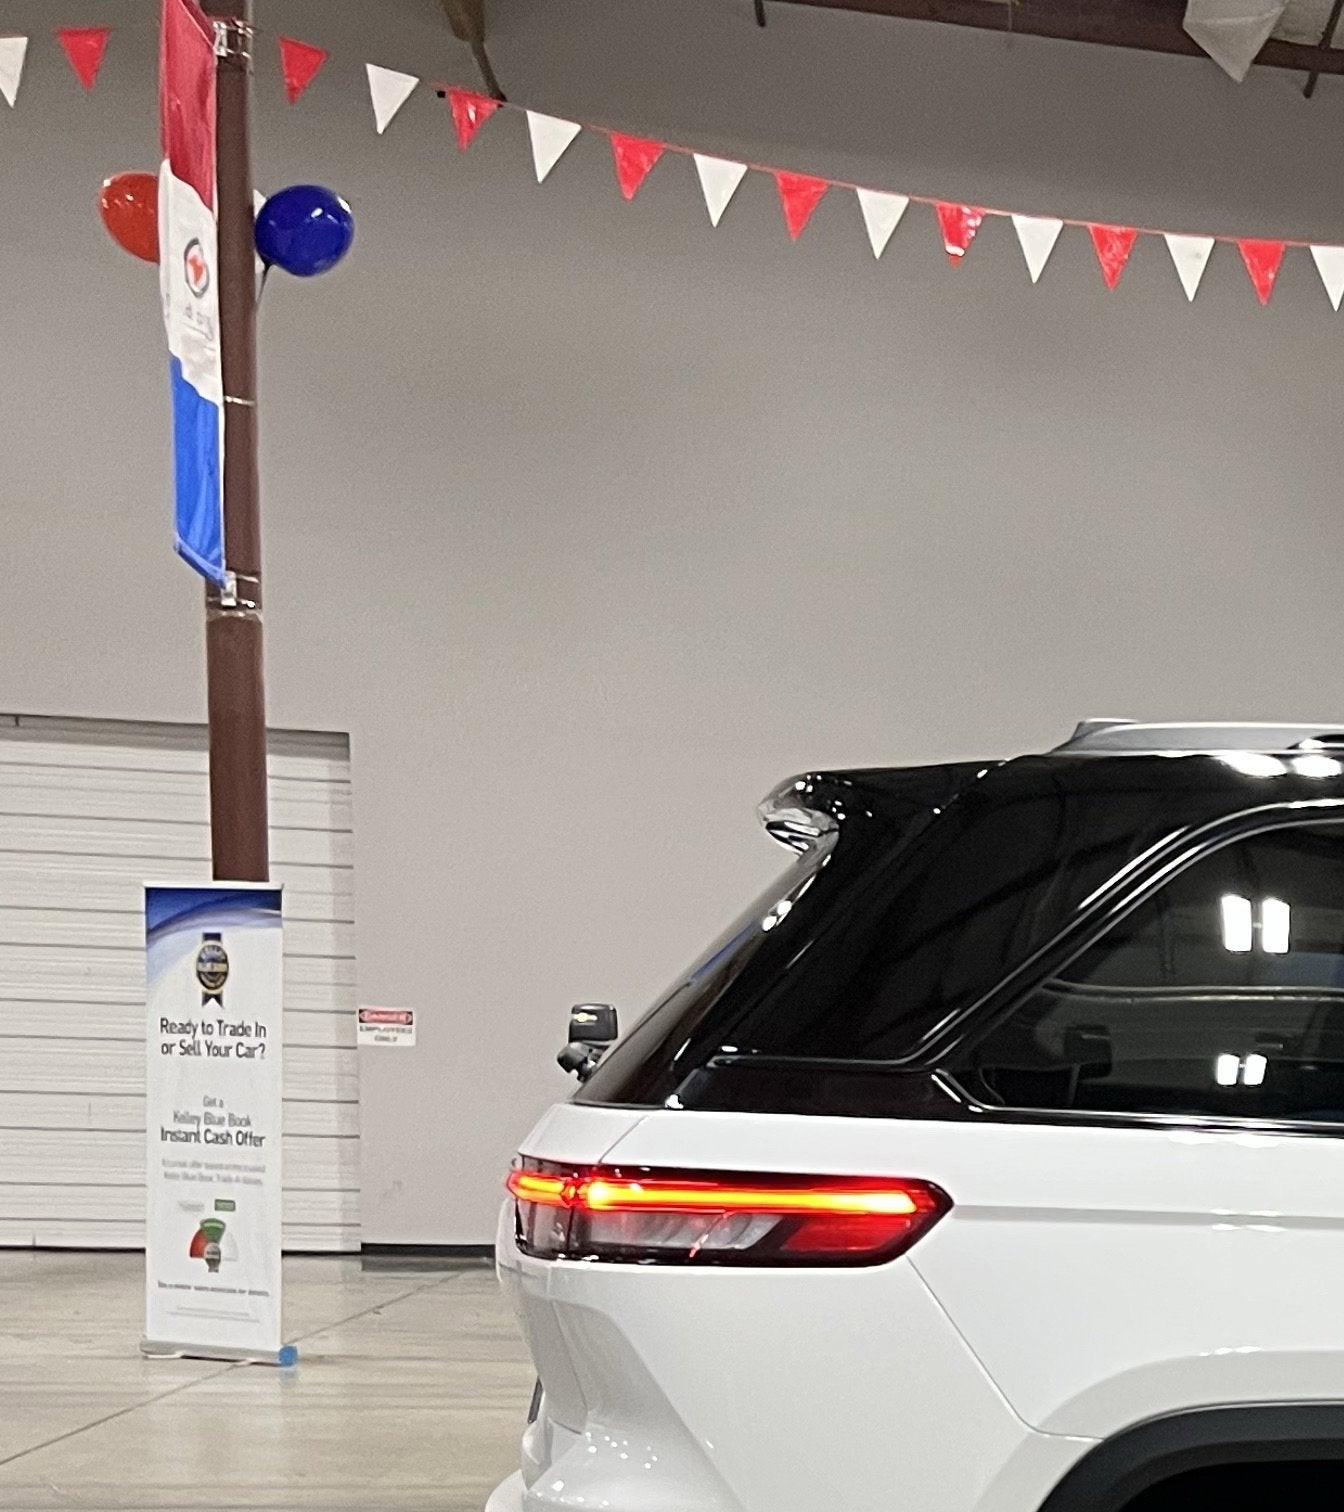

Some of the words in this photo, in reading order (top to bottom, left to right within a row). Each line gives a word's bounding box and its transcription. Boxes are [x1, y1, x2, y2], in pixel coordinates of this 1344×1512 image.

[160, 1017, 198, 1039] Ready
[201, 1020, 214, 1036] to
[216, 1019, 252, 1037] Trade
[255, 1021, 267, 1038] In
[161, 1042, 175, 1055] or
[179, 1039, 201, 1057] Sell
[205, 1039, 232, 1057] Your
[236, 1042, 266, 1060] Car?
[161, 1126, 201, 1143] Instant
[203, 1128, 233, 1145] Cash
[236, 1130, 266, 1147] Offer
